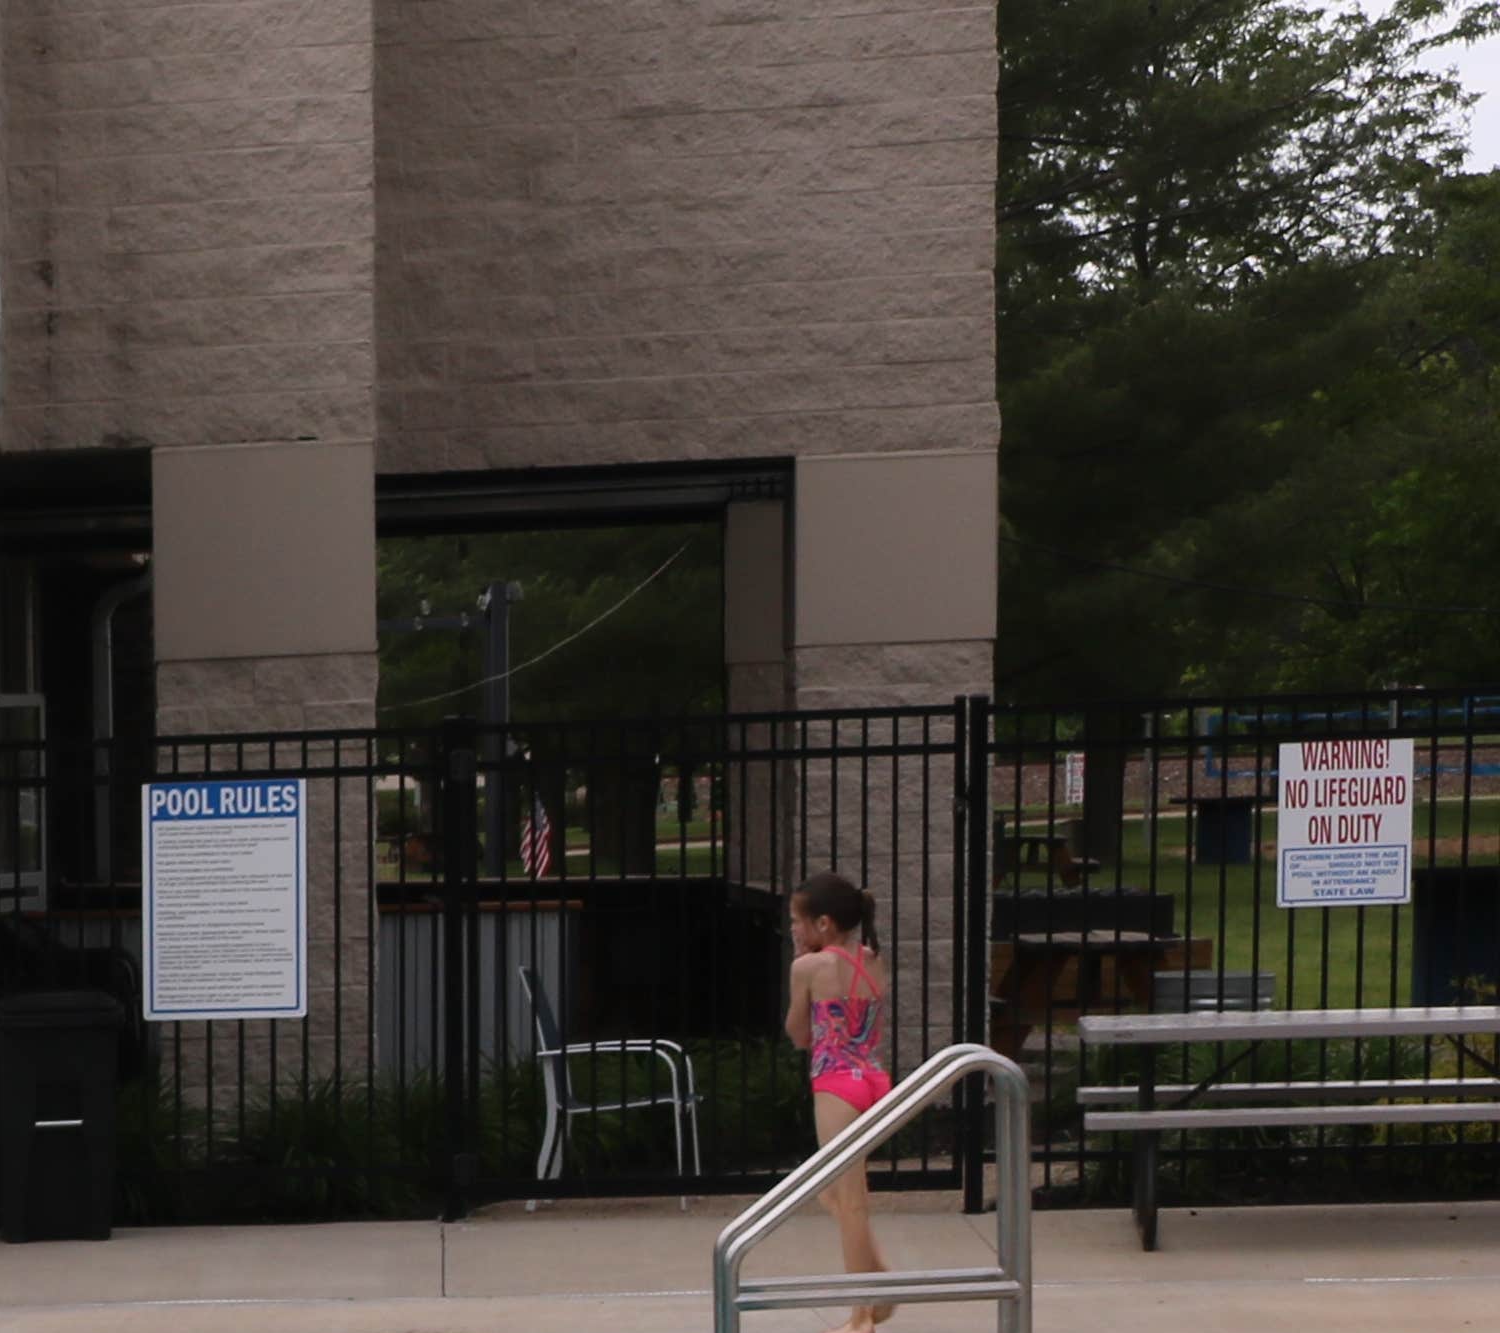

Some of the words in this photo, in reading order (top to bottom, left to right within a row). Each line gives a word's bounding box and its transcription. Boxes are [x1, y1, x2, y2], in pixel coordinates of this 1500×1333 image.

[1301, 739, 1390, 771] WARNING!
[1285, 779, 1309, 809] NO
[1315, 775, 1406, 808] LIFEGUARD
[152, 788, 214, 817] POOL
[220, 785, 297, 815] RULES
[1308, 815, 1331, 845] ON
[1338, 814, 1382, 844] DUTY
[1290, 854, 1331, 862] CHILDREN
[1364, 851, 1379, 859] THE
[1289, 862, 1300, 870] OF
[1383, 859, 1399, 867] USE
[1316, 869, 1353, 877] WITHOUT
[1371, 868, 1397, 876] ADULT
[1322, 877, 1376, 886] ATTENDANCE
[1313, 888, 1347, 897] STATE
[1349, 887, 1375, 896] LAW
